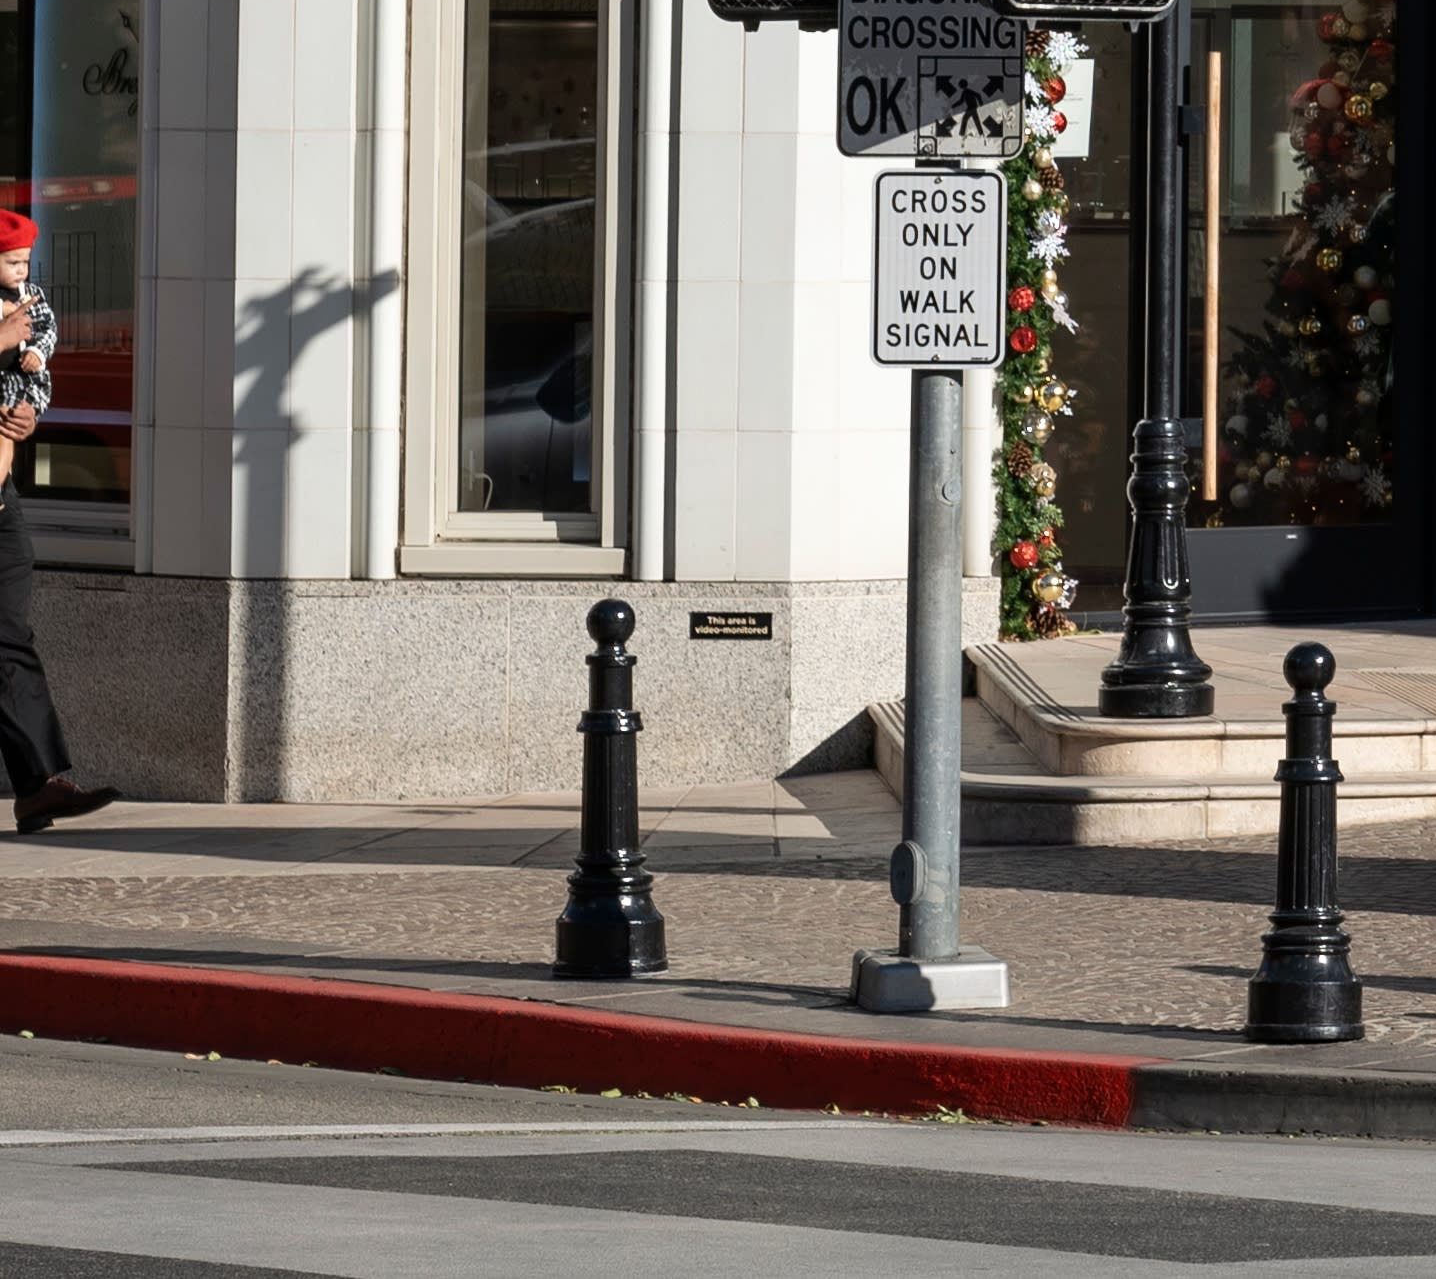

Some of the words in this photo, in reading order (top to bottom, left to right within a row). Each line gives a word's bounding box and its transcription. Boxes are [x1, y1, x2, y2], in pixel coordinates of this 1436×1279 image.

[847, 16, 1017, 49] CROSSING
[846, 75, 908, 136] OK
[892, 189, 986, 213] CROSS
[902, 223, 974, 247] ONLY
[919, 256, 957, 281] ON
[899, 290, 975, 314] WALK
[885, 323, 989, 347] SIGNAL
[707, 616, 725, 625] This
[727, 617, 747, 625] area
[749, 616, 757, 625] is
